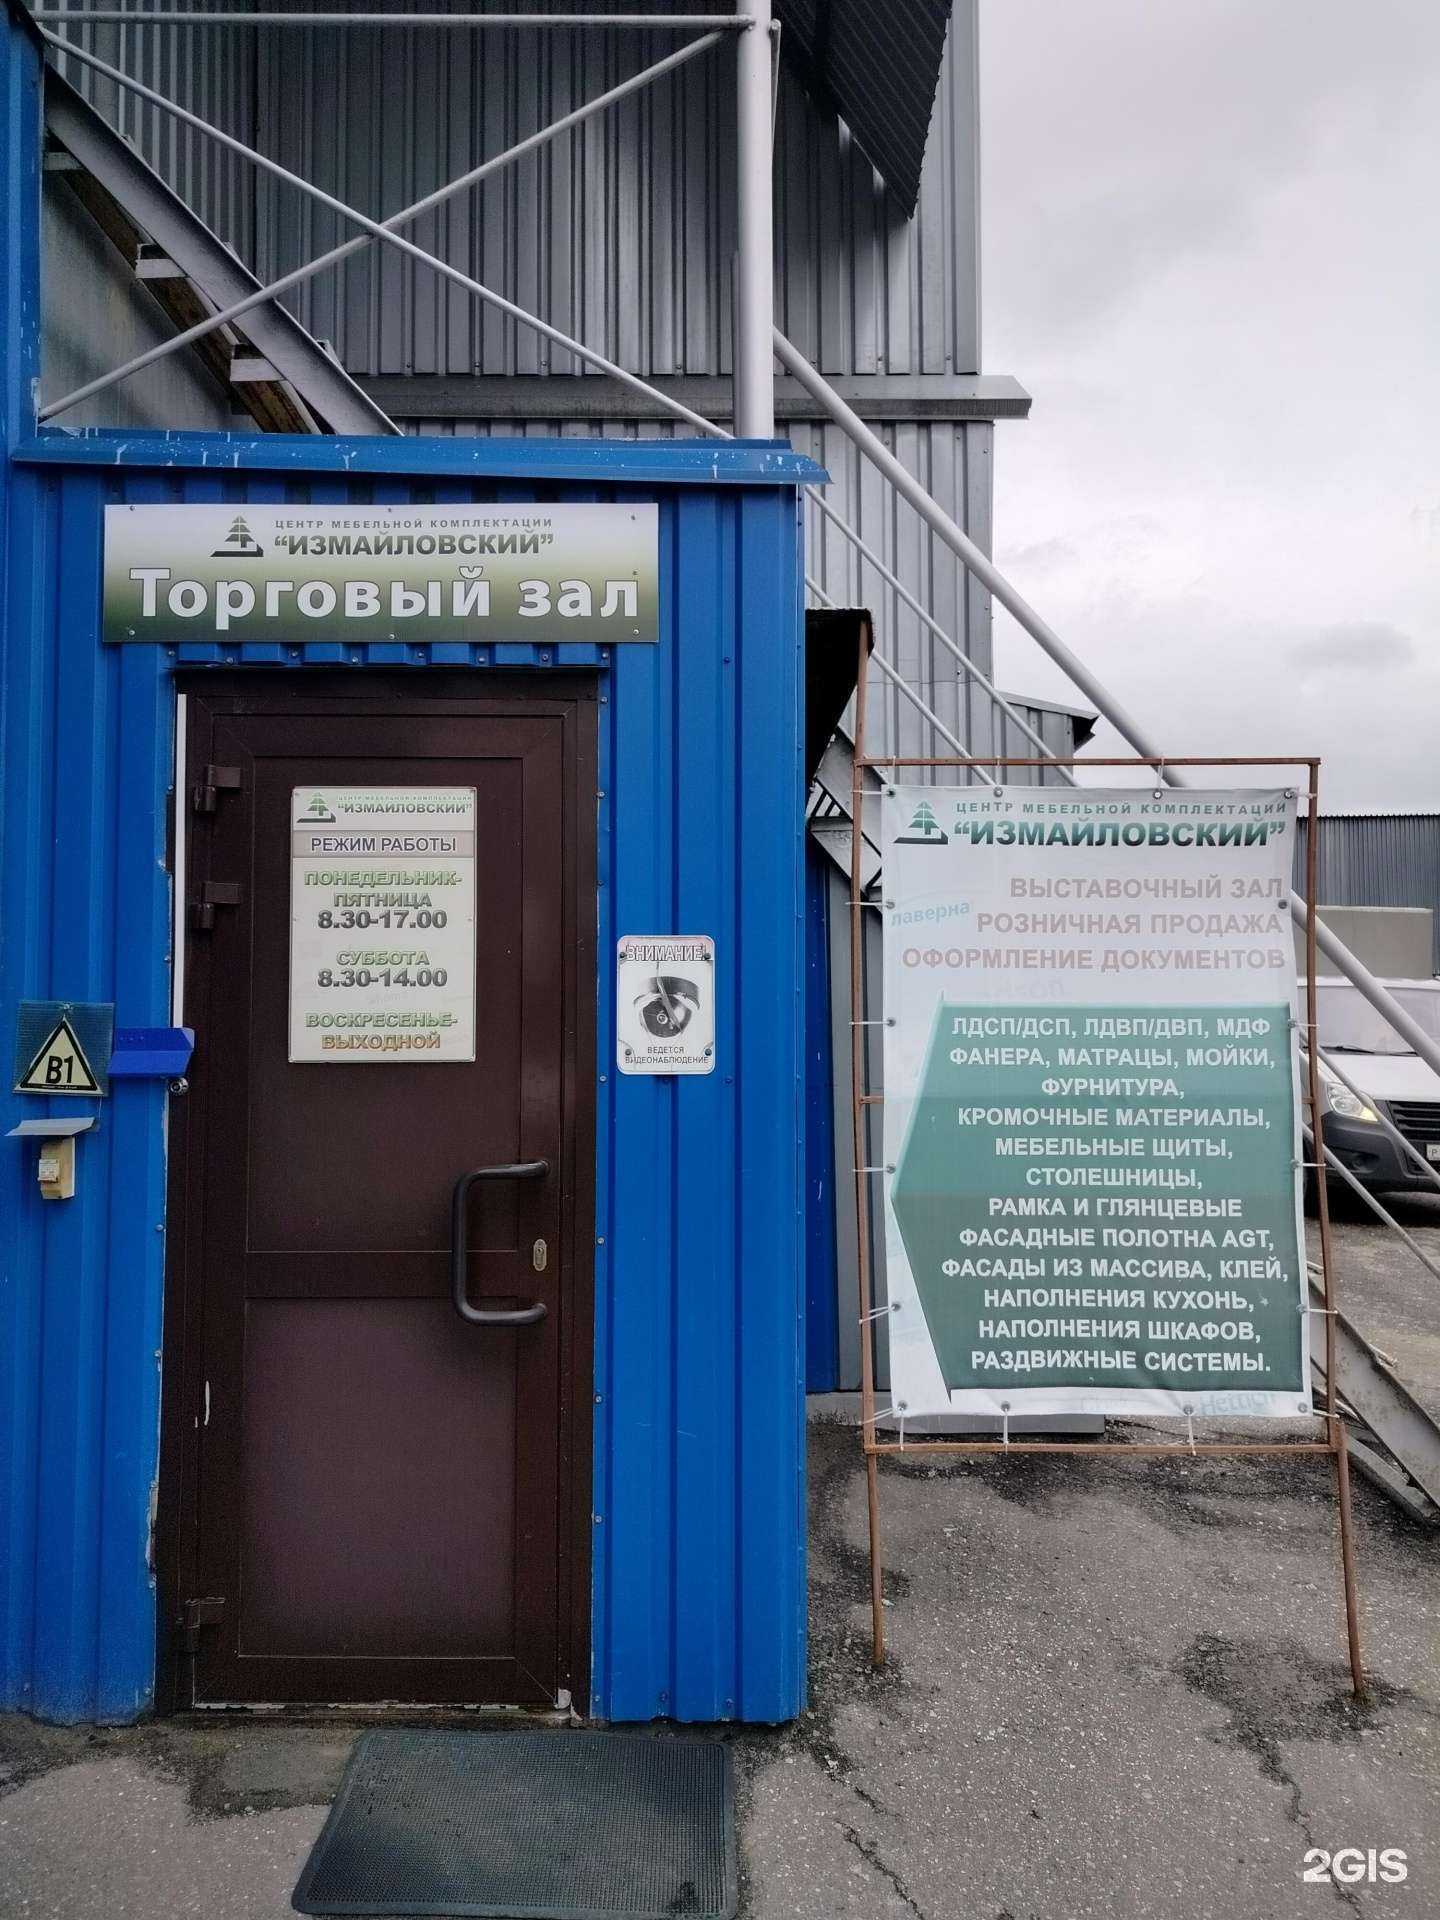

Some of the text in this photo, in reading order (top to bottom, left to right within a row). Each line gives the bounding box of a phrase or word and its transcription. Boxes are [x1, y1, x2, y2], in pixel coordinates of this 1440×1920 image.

[275, 518, 552, 529] ЦЕНТР МЕБЕЛЬНОЙ КОМПЛЕКТАЦИИ
[129, 565, 638, 630] Торговый зал
[956, 802, 1286, 816] ЦЕНТР МЕБЕЛЬНОЙ КОМПЛЕКТАЦИИ
[311, 837, 456, 851] РЕЖИМ РАБОТЫ
[304, 871, 462, 888] ПОНЕДЕЛЬНИК-
[1010, 874, 1283, 898] ВЫСТАВОЧНЫЙ ЗАЛ
[333, 893, 432, 908] ПЯТНИЦА
[317, 910, 448, 929] 8.30-17.00
[977, 912, 1284, 938] РОЗНИЧНАЯ ПРОДАЖА
[336, 951, 429, 966] СУББОТА
[902, 948, 1285, 973] ОФОРМЛЕНИЕ ДОКУМЕНТОВ
[317, 968, 448, 987] 8.30-14.00
[305, 1013, 457, 1028] ВОСКРЕСЕНЬЕ-
[952, 1018, 1270, 1039] ЛДСП/ДСП, ЛДВП/ДВП, МДФ
[321, 1031, 441, 1051] ВЫХОДНОЙ
[647, 1046, 685, 1055] ВЕДЕТСЯ
[625, 1056, 709, 1065] ВИДЕОНАБЛЮДЕНИЕ
[950, 1044, 1276, 1069] ФАНЕРА, МАТРАЦЫ, МОЙКИ,
[1041, 1079, 1184, 1100] ФУРНИТУРА,
[958, 1108, 1271, 1130] КРОМОЧНЫЕ МАТЕРИАЛЫ,
[995, 1138, 1233, 1159] МЕБЕЛЬНЫЕ ЩИТЫ,
[1026, 1168, 1202, 1189] СТОЛЕШНИЦЫ,
[989, 1198, 1242, 1219] РАМКА И ГЛЯНЦЕВЫЕ
[959, 1229, 1274, 1250] ФАСАДНЫЕ ПОЛОТНА AGT,
[941, 1256, 1288, 1282] ФАСАДЫ ИЗ МАССИВА, КЛЕЙ,
[984, 1289, 1254, 1312] НАПОЛНЕНИЯ КУХОНЬ,
[979, 1320, 1261, 1343] НАПОЛНЕНИЯ ШКАФОВ,
[971, 1351, 1271, 1372] РАЗДВИЖНЫЕ СИСТЕМЫ.
